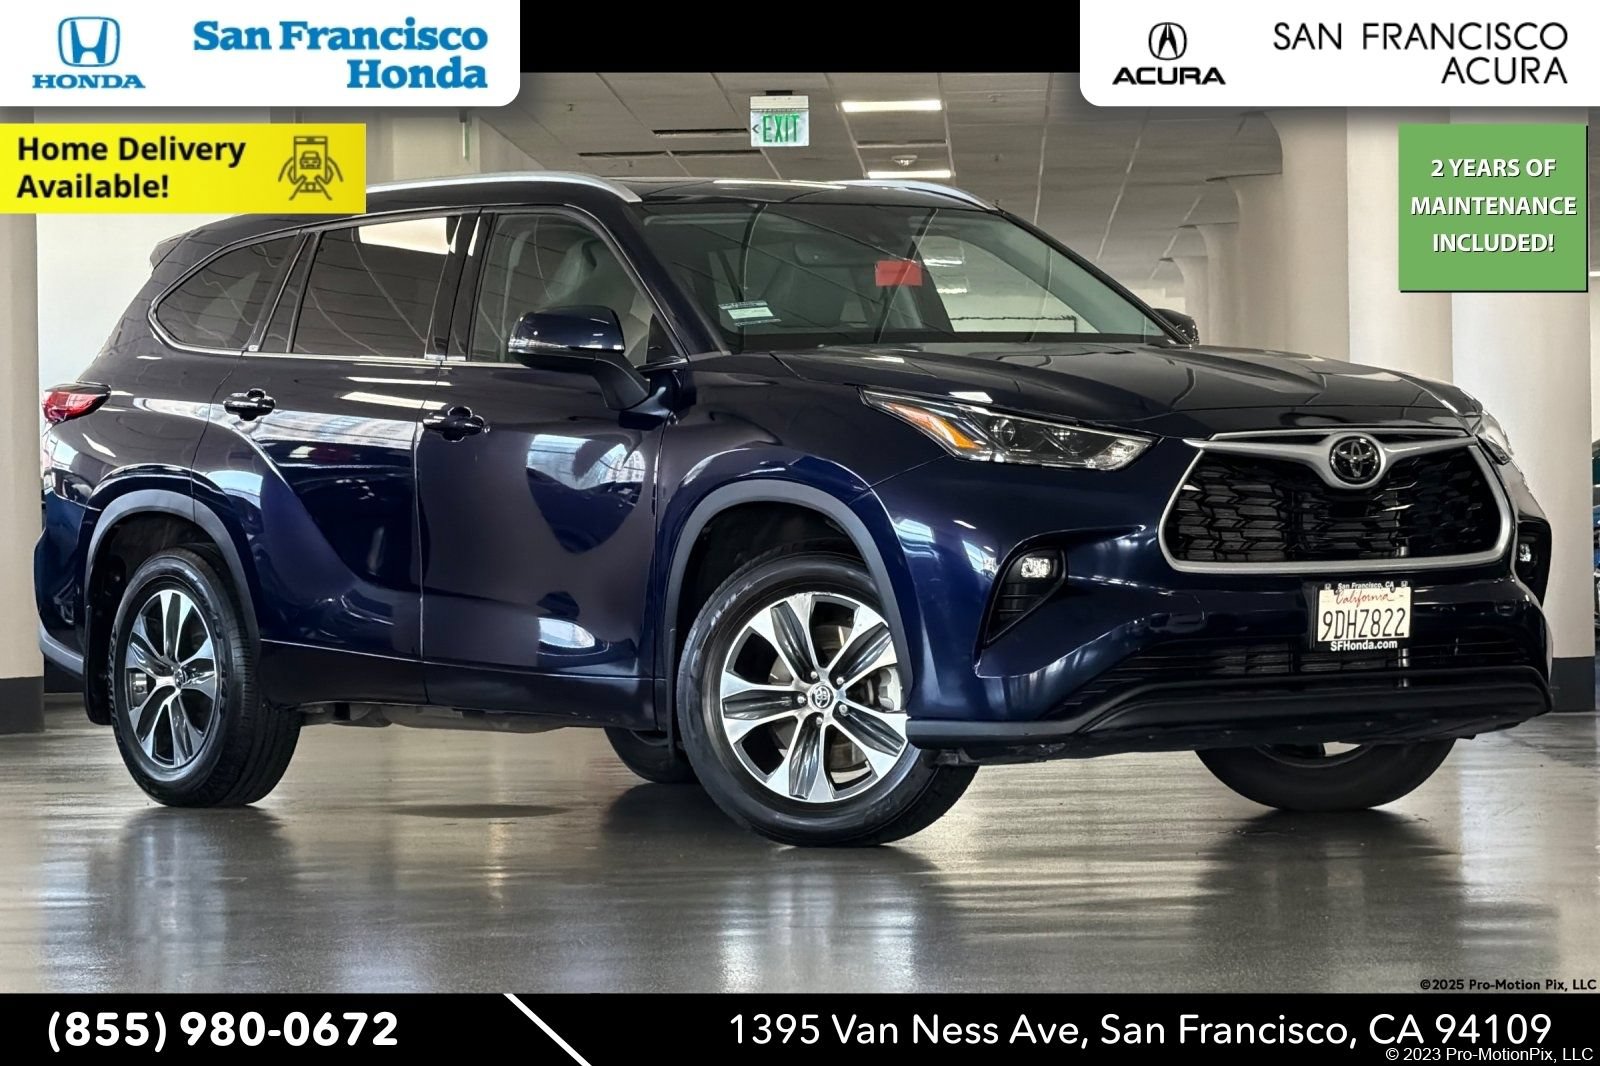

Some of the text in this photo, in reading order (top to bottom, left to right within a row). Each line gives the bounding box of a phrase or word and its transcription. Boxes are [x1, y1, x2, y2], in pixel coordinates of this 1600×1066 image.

[762, 113, 800, 142] EXIT
[1335, 590, 1395, 608] California
[1321, 607, 1406, 641] 9DHZ822
[1330, 640, 1398, 651] SFHonda.com
